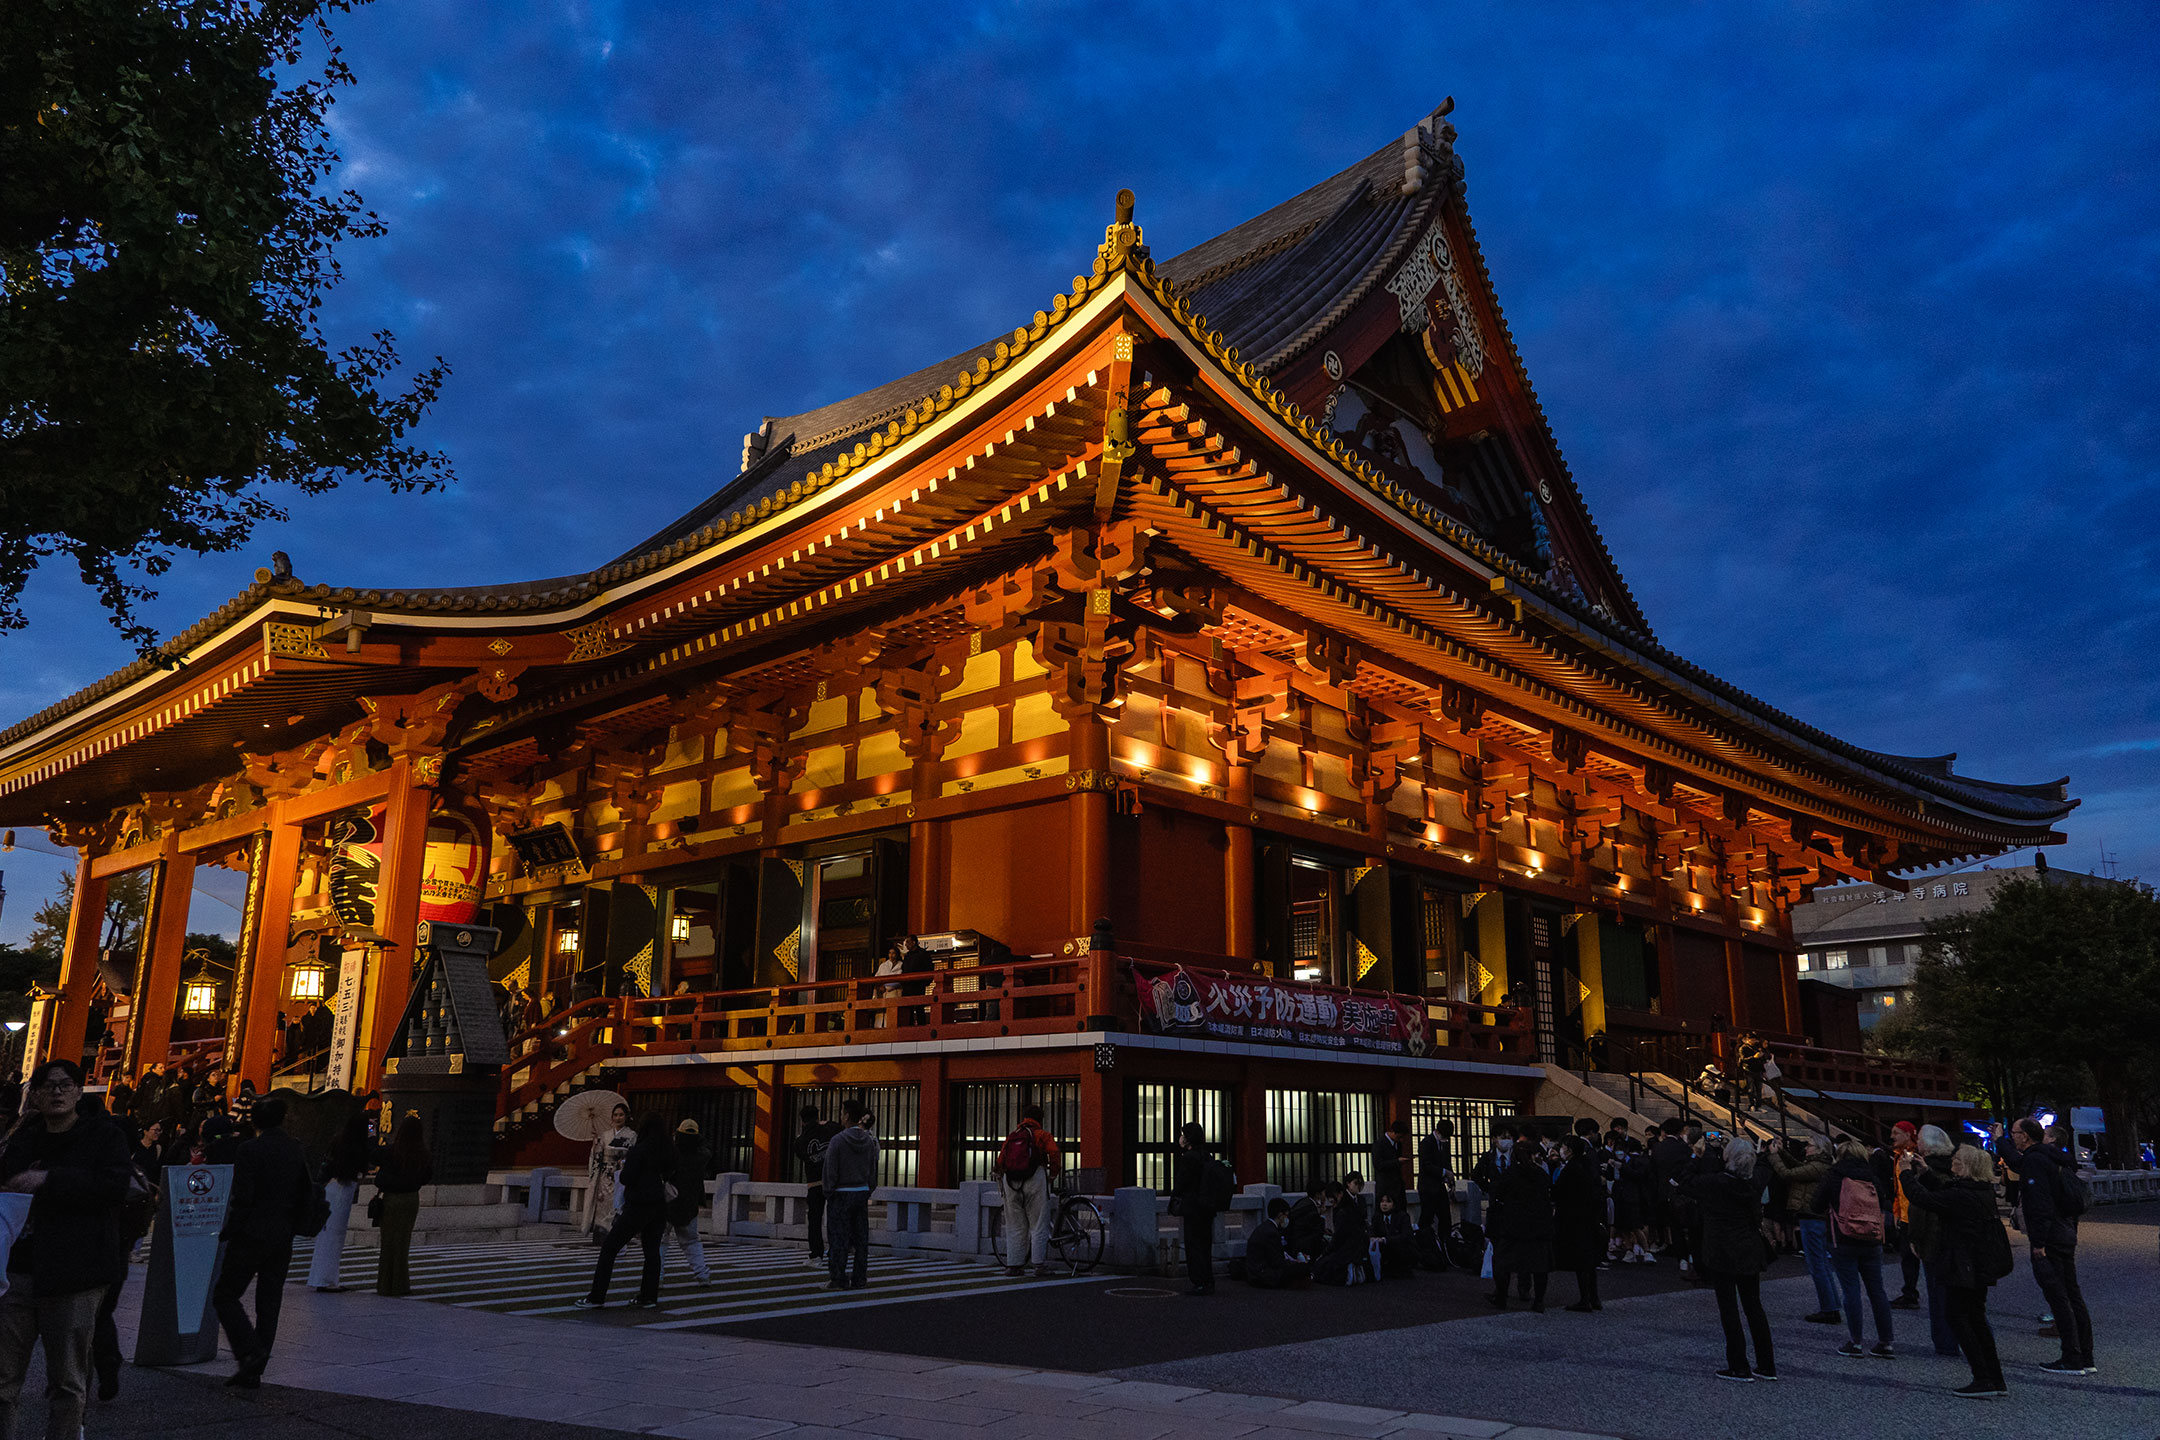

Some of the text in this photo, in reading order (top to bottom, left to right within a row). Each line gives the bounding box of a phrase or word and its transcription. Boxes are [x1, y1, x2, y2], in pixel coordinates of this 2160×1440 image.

[1823, 892, 1870, 905] 社会福祉法人
[1206, 982, 1397, 1035] 火災予防運動 実施中
